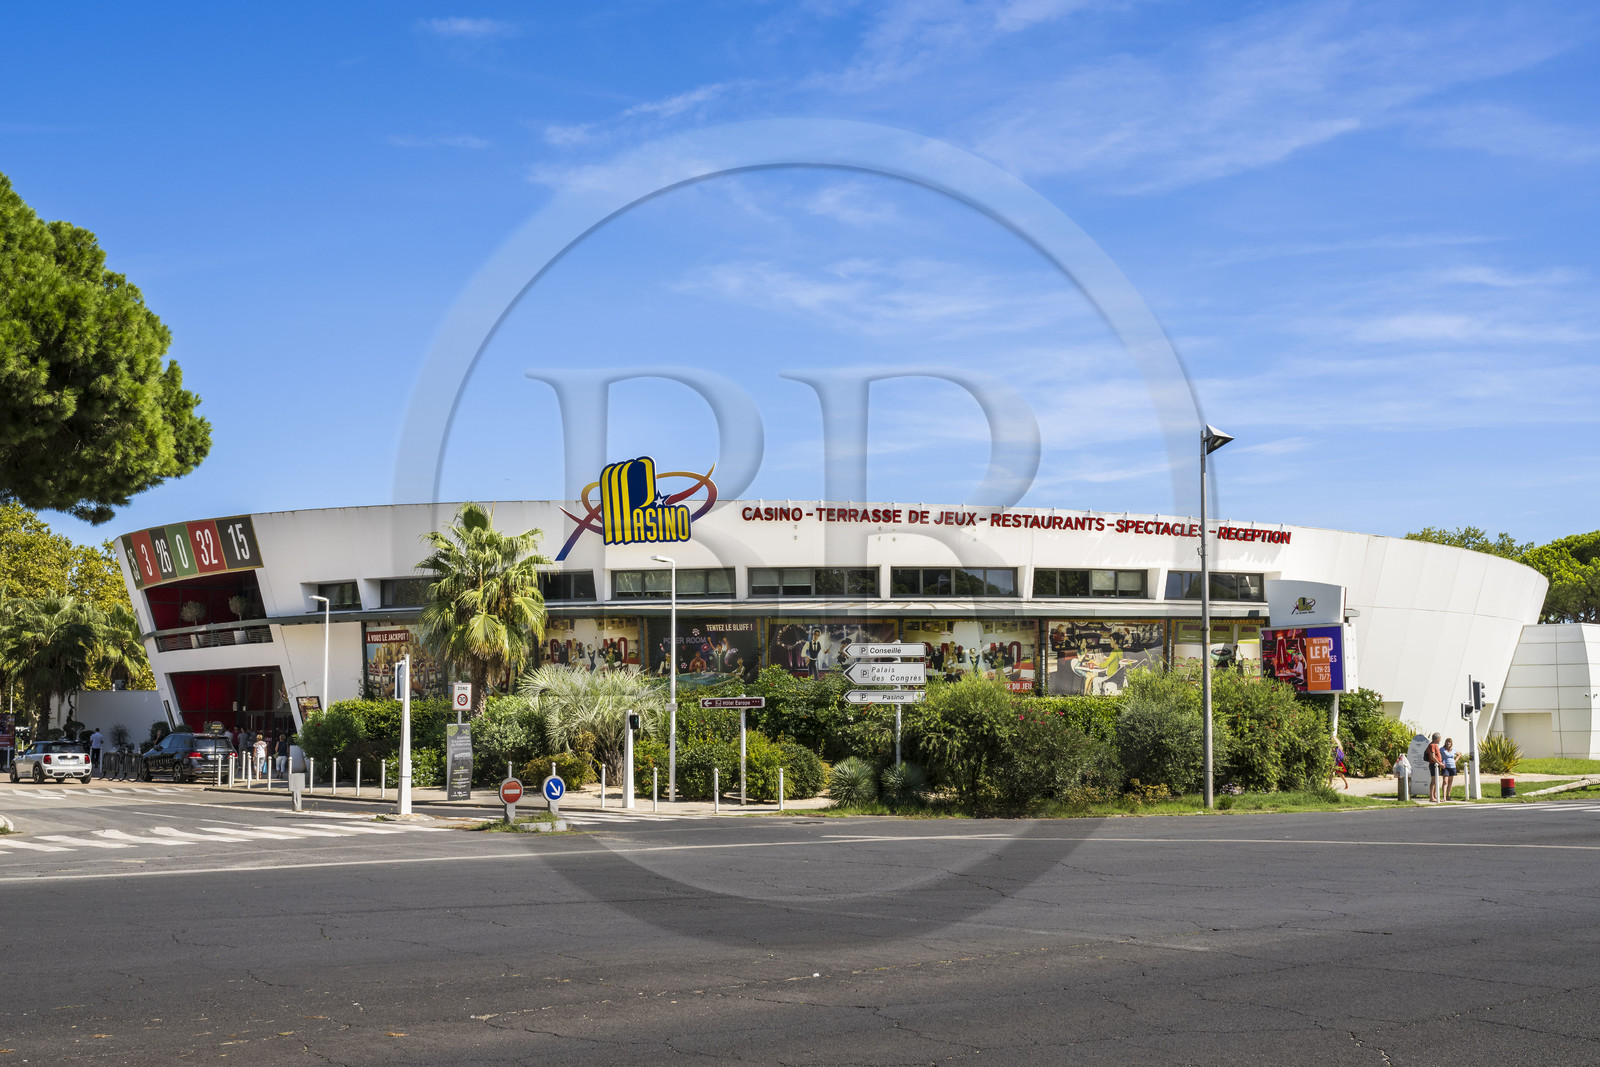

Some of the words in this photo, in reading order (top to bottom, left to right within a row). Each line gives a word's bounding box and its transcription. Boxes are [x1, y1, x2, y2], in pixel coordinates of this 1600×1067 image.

[742, 507, 803, 521] CASINO
[816, 507, 902, 523] TERRASSE
[908, 510, 930, 524] DE
[934, 511, 976, 526] JEUX
[990, 513, 1105, 532] RESTAURANTS
[1217, 526, 1292, 545] RECEPTION
[141, 543, 153, 577] 3
[155, 538, 173, 573] 26
[175, 534, 189, 569] 0
[195, 528, 219, 566] 32
[227, 523, 251, 561] 15
[1310, 646, 1320, 659] LE
[890, 674, 922, 682] Congrès
